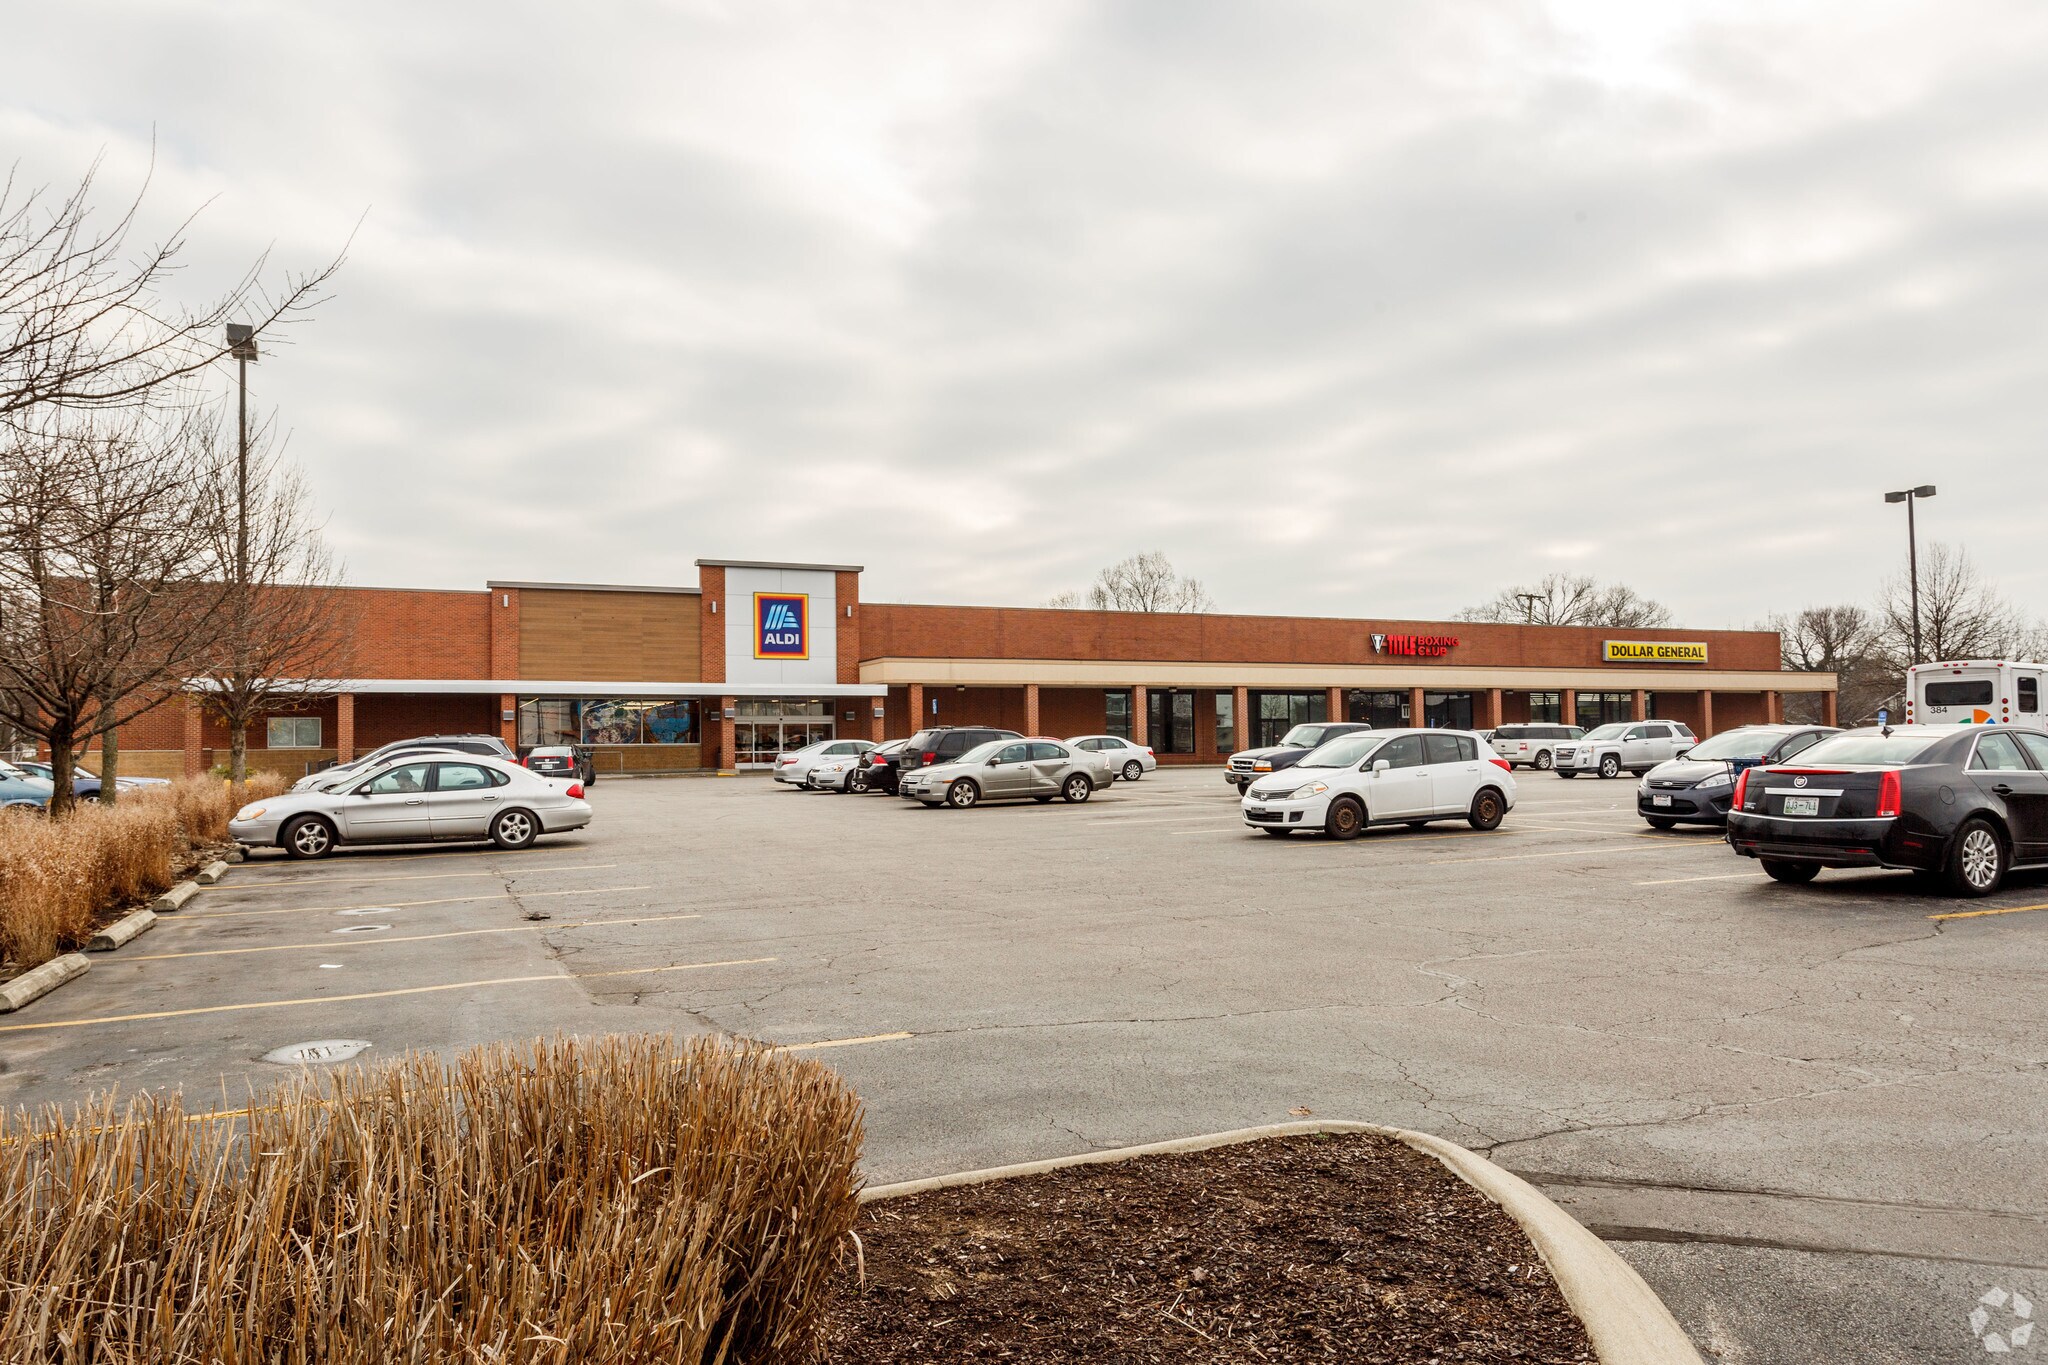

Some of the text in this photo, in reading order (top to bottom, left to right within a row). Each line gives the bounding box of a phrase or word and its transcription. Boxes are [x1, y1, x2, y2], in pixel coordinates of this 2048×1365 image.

[764, 633, 800, 645] ALDI
[1387, 634, 1417, 656] TITLE
[1417, 635, 1460, 647] BOXING
[1417, 646, 1447, 657] CLUB
[1611, 645, 1704, 658] DOLLAR GENERAL
[1930, 706, 1948, 714] 384
